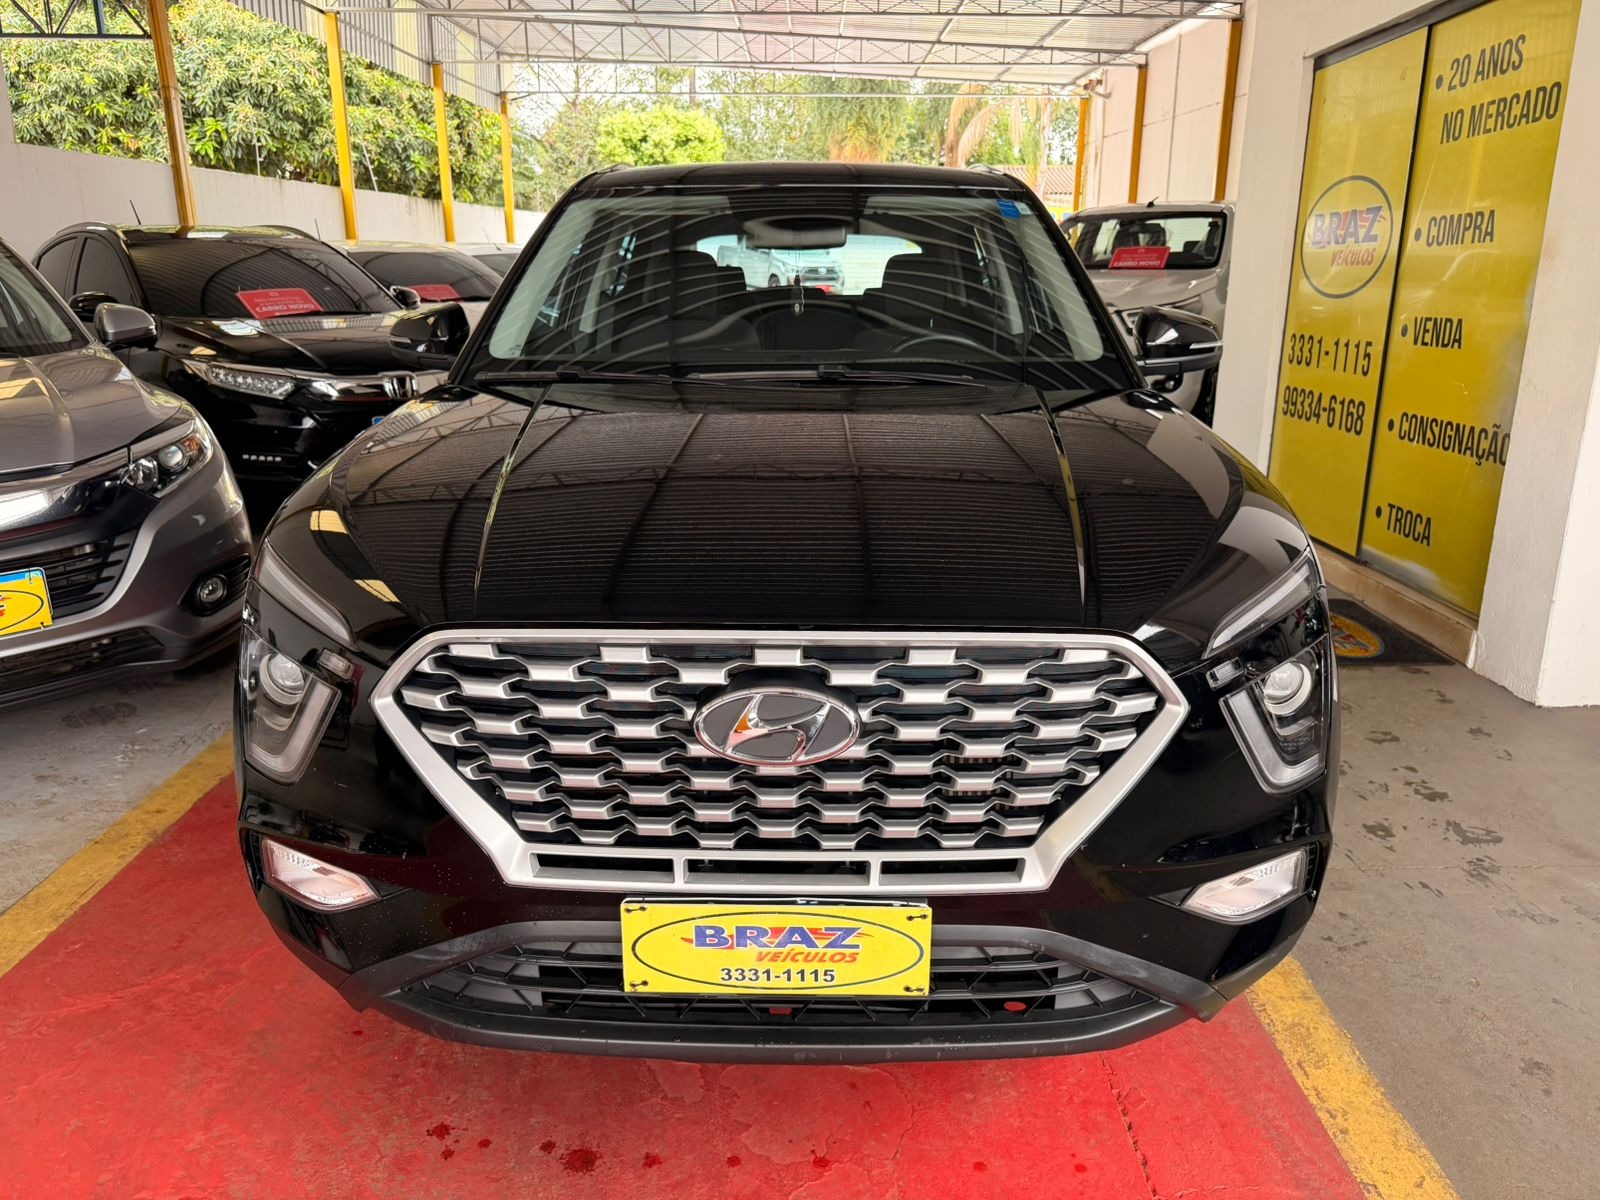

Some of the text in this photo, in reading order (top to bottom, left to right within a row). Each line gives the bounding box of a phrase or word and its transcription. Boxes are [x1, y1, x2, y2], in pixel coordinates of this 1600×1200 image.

[1447, 34, 1526, 92] 20 ANOS
[1440, 81, 1562, 145] NO MERCADO
[1312, 206, 1383, 246] BRAZ
[1426, 209, 1495, 248] COMPRA
[1413, 316, 1463, 349] VENDA
[1288, 333, 1372, 377] 3331-1115
[1282, 385, 1366, 436] 99334-6168
[1398, 412, 1510, 466] CONSIGNAÇÃO
[1386, 503, 1432, 547] TROCA
[693, 926, 862, 949] BRAZ
[755, 949, 859, 963] VEÍCULOS
[720, 968, 836, 983] 3331-1115
